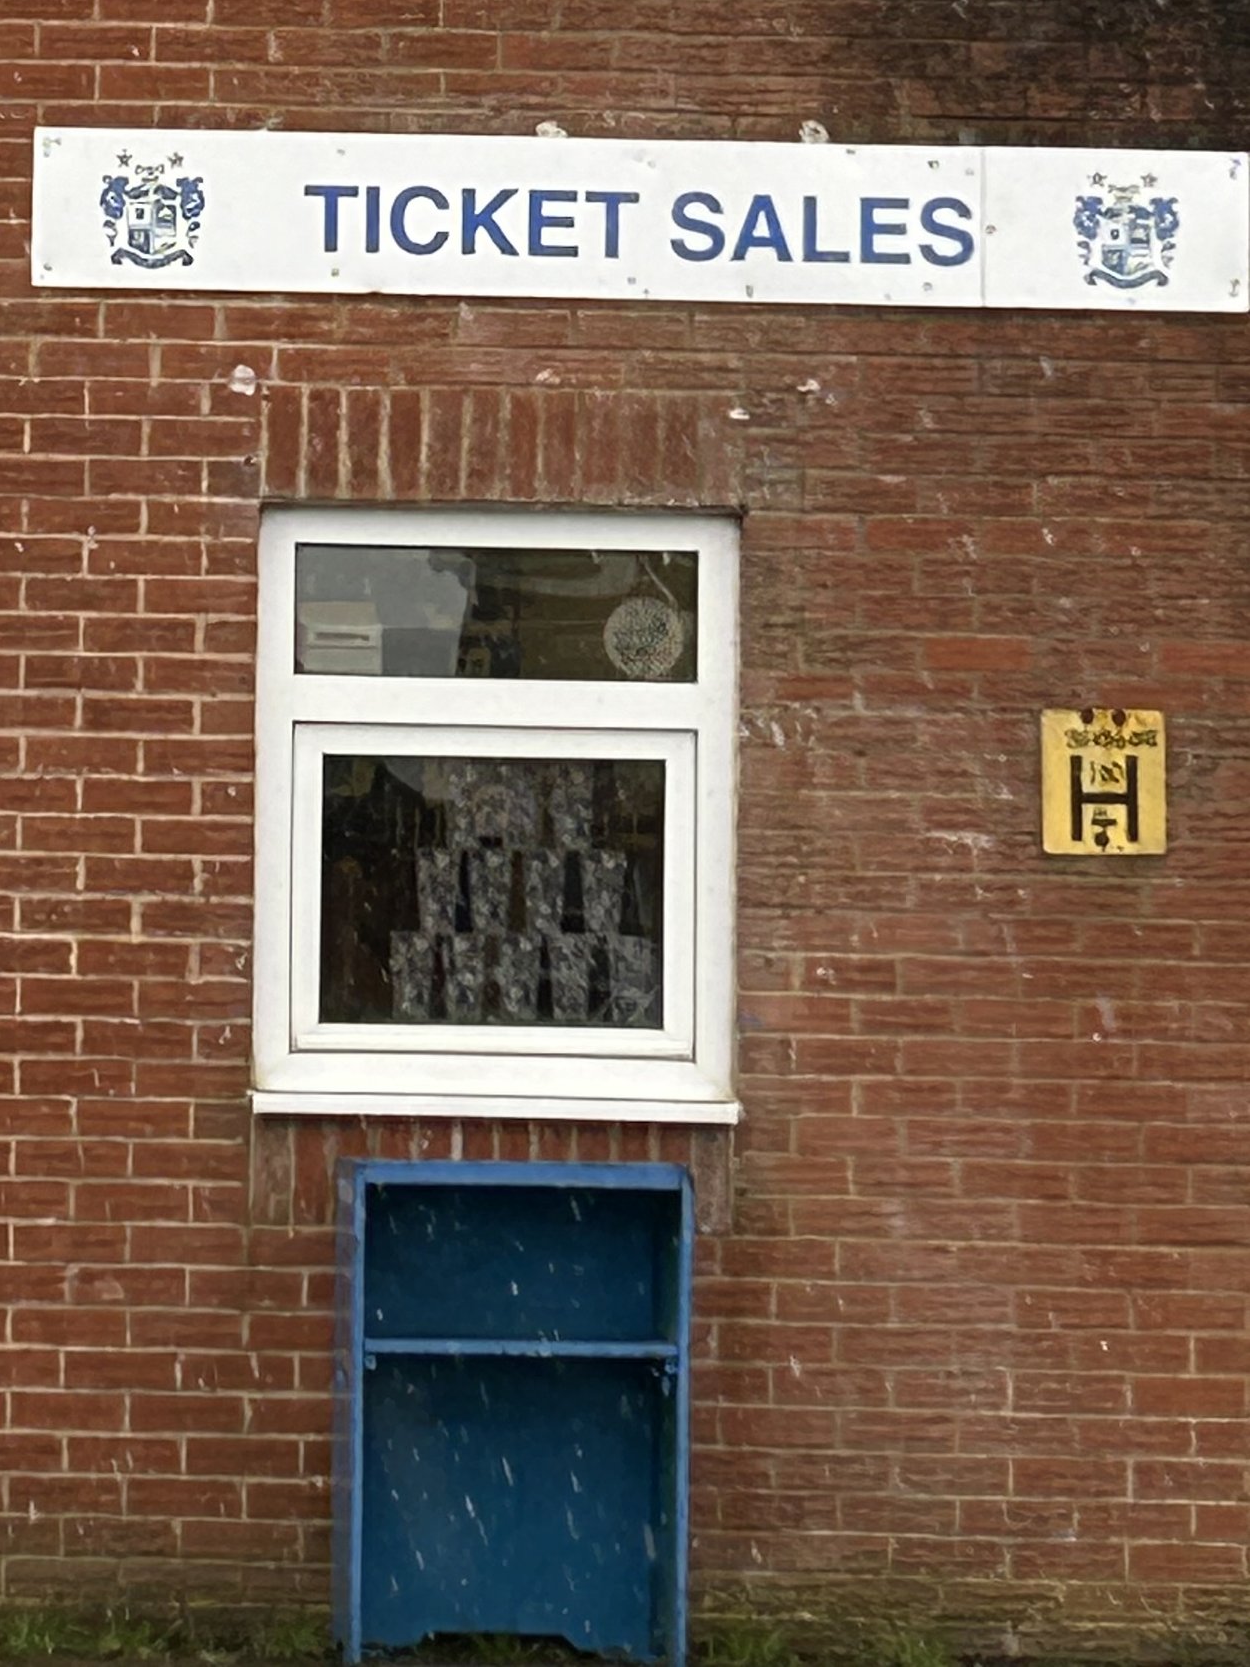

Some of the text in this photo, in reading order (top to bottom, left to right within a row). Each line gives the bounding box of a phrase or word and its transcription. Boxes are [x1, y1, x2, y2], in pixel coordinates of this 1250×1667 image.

[304, 184, 975, 267] TICKET SALES
[1070, 754, 1139, 842] H
